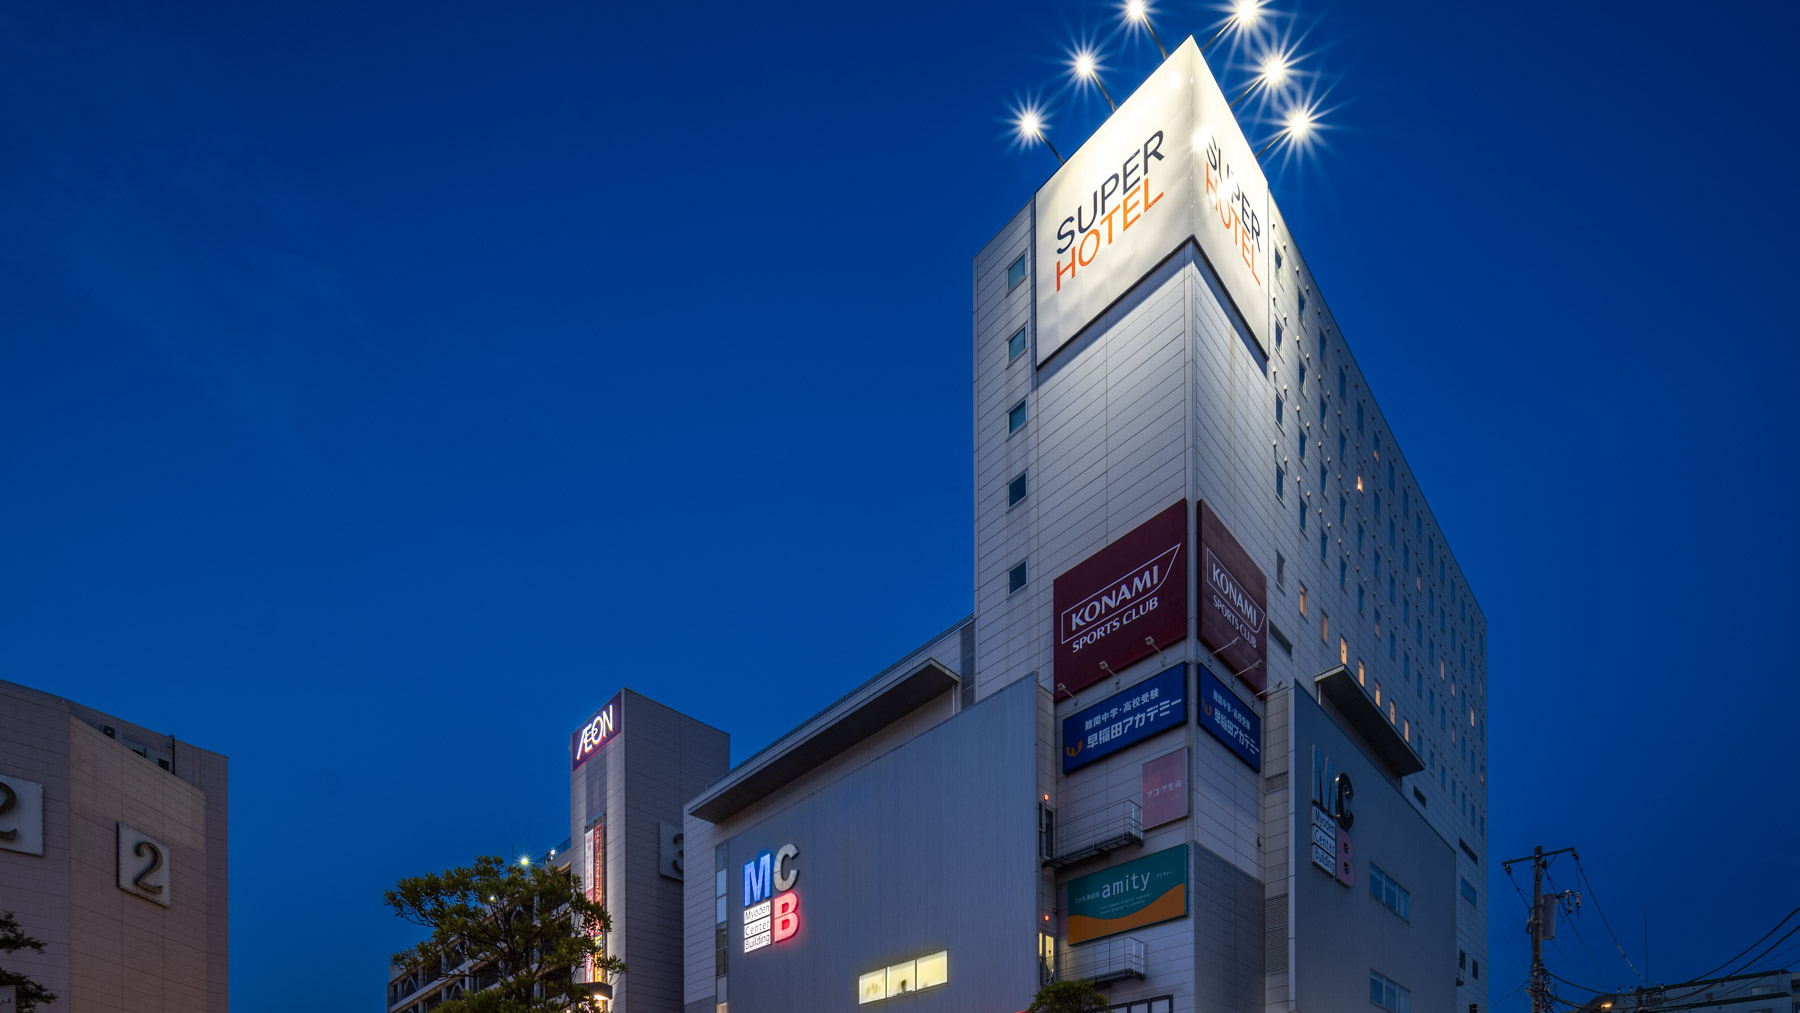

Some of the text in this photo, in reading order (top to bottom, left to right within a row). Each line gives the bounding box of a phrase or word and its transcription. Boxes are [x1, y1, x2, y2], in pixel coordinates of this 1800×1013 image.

[1056, 130, 1164, 254] SUPER
[1056, 177, 1164, 293] HOTEL
[1071, 564, 1159, 632] KONAMI
[1212, 563, 1257, 627] KONAMI
[1072, 596, 1158, 653] SPORTS CLUB
[1213, 594, 1257, 649] SPORTS CLUB
[1086, 698, 1182, 749] 早稲田アカデミー
[1214, 707, 1260, 755] 早稲田アカデミー
[1146, 778, 1182, 799] フコク生命
[1314, 829, 1335, 854] Center
[1314, 847, 1335, 876] Building
[134, 841, 164, 894] 2
[1102, 871, 1150, 899] amity
[745, 903, 770, 920] Myoden
[745, 919, 770, 936] Center
[745, 934, 770, 950] Building
